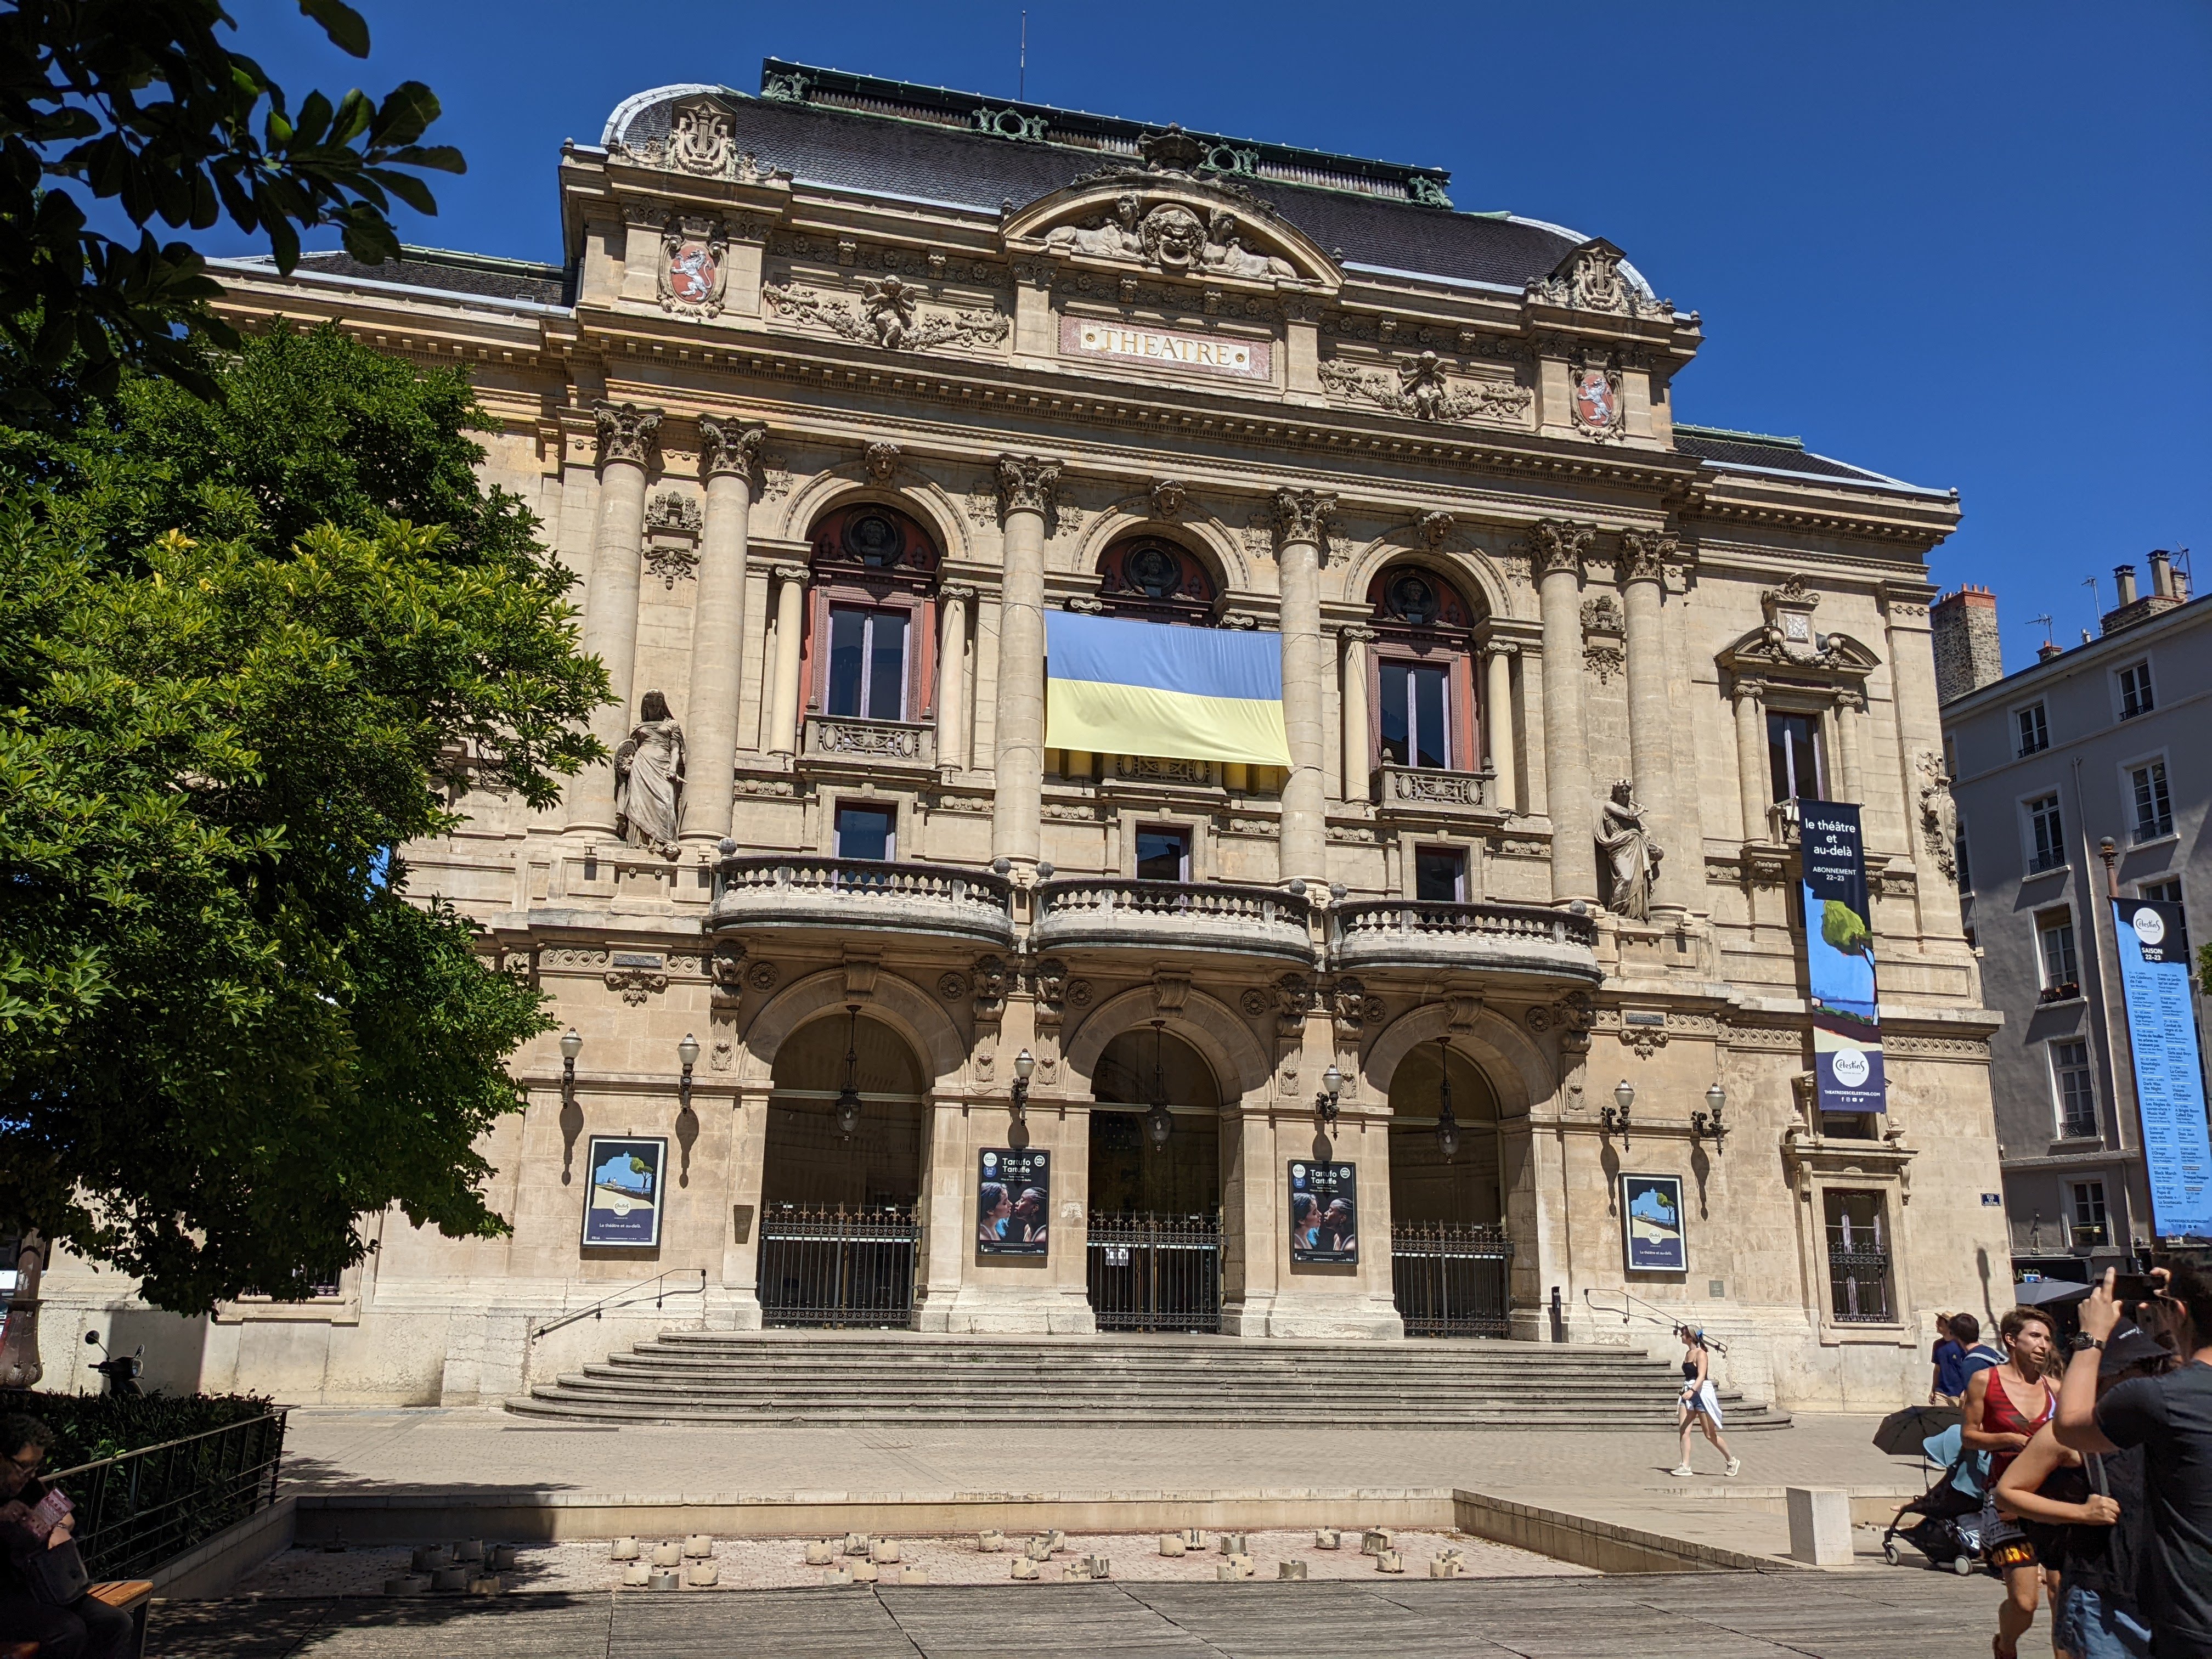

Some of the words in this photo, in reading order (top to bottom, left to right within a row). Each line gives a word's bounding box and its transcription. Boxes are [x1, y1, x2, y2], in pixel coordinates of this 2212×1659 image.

[1100, 329, 1231, 365] THEATRE
[1805, 818, 1814, 829] le
[1818, 820, 1855, 832] théâtre
[1826, 834, 1837, 843] et
[1814, 845, 1852, 856] au-delà
[1813, 867, 1856, 875] ABONNEMENT
